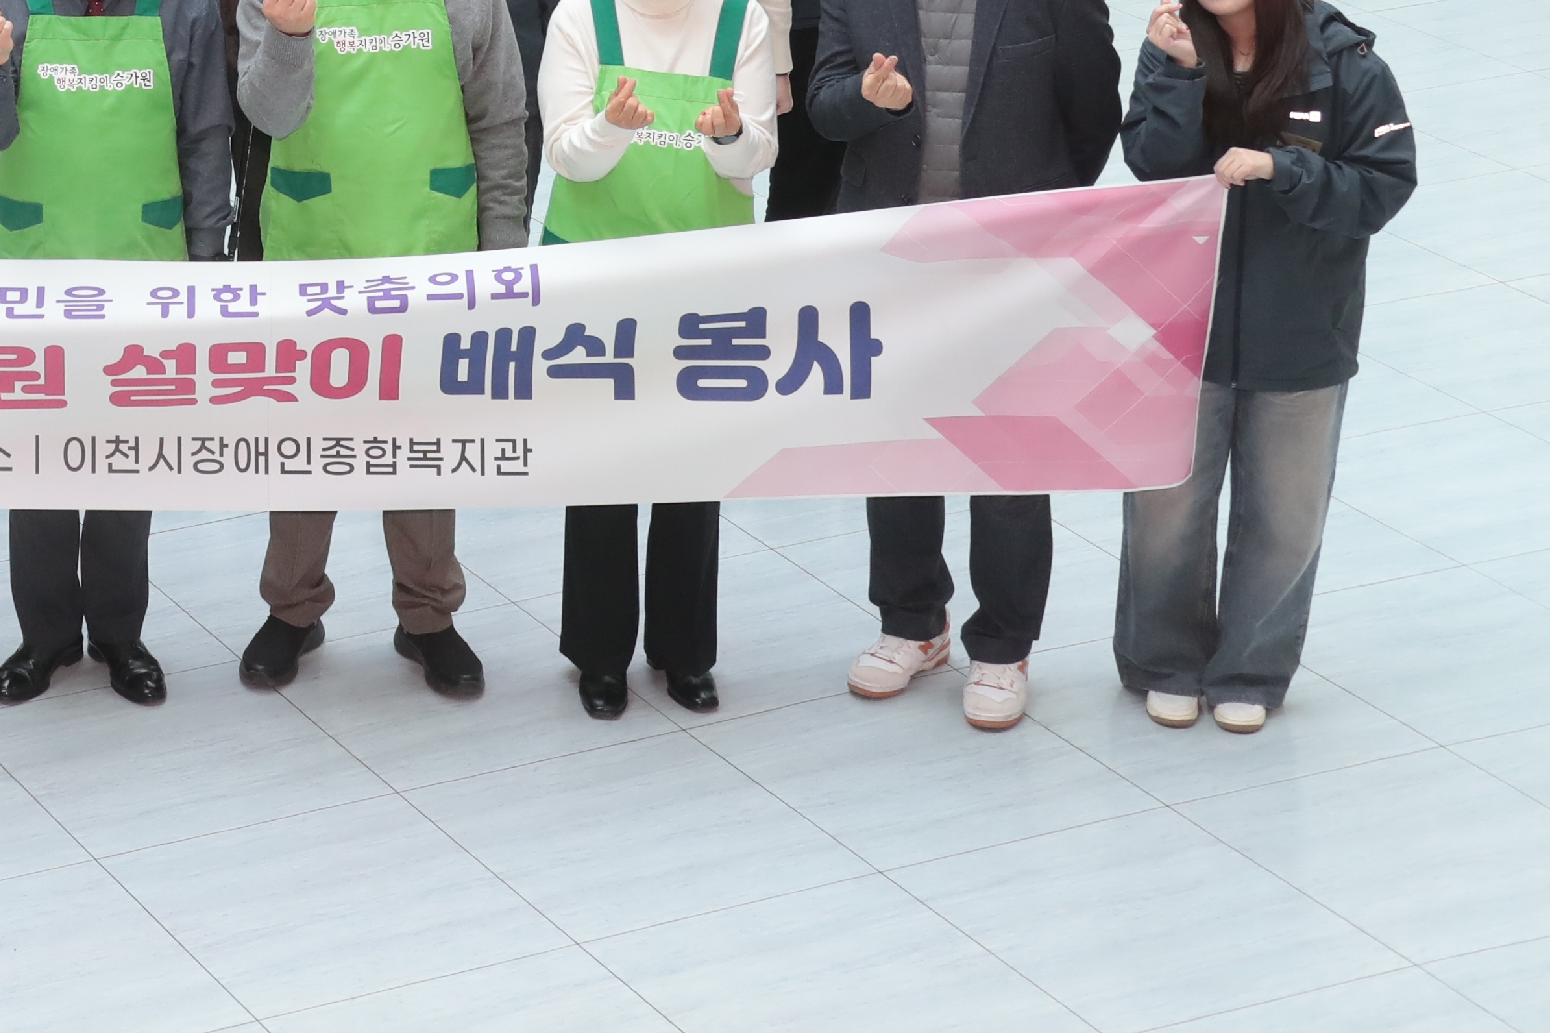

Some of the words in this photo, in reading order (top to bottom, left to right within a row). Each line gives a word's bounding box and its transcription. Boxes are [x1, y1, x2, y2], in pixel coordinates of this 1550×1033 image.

[317, 29, 357, 42] 장애가족
[390, 31, 432, 49] 승가원
[38, 65, 78, 77] 장애가족
[112, 70, 153, 89] 승가원
[146, 283, 267, 319] 위한
[298, 263, 542, 318] 맞춤의회
[102, 333, 404, 409] 설맞이
[439, 317, 638, 401] 배식
[672, 301, 883, 402] 봉사
[63, 435, 534, 477] 이천시장애인종합복지관
